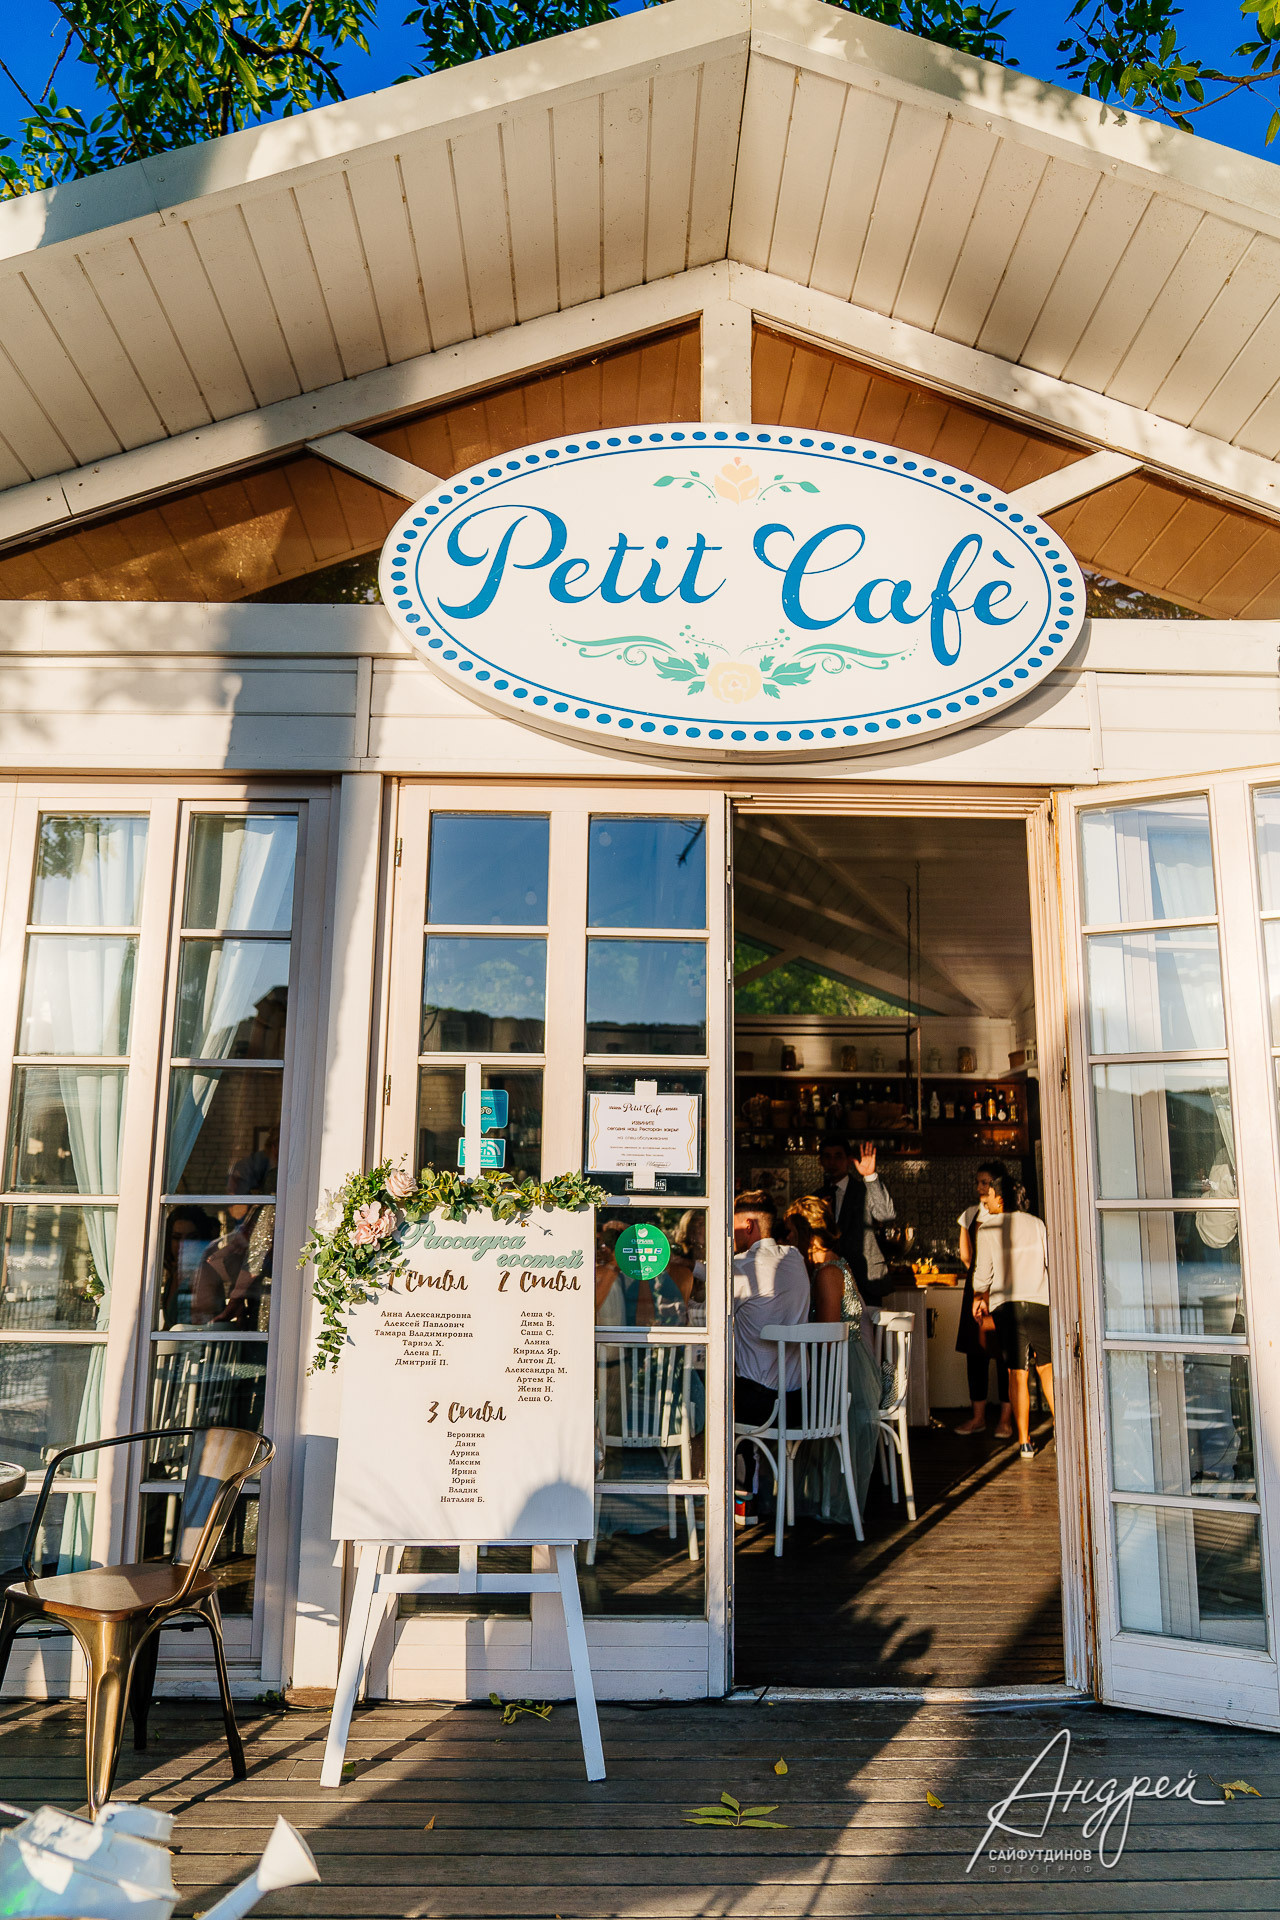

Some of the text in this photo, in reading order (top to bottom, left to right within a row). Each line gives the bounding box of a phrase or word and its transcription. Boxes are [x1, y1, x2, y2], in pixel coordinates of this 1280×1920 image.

[437, 504, 1029, 668] Petit Cafè
[400, 1220, 527, 1262] Рассадка
[496, 1250, 585, 1269] гостей
[497, 1270, 581, 1293] 2 Стол
[380, 1310, 472, 1321] Анна Александровна
[520, 1310, 543, 1318] Леша
[383, 1320, 465, 1329] Алексей Павлович
[520, 1320, 544, 1328] Дима
[374, 1329, 474, 1340] Тамара Владимировна
[545, 1329, 555, 1337] С.
[401, 1339, 433, 1348] Тариэл
[403, 1349, 430, 1357] Алена
[513, 1347, 561, 1357] Кирилл Яр.
[394, 1358, 437, 1368] Дмитрий
[516, 1357, 556, 1365] Антон Д.
[504, 1366, 556, 1376] Александра
[516, 1376, 544, 1385] Артем
[517, 1385, 554, 1393] Женя Н.
[426, 1400, 507, 1424] 3 Стол
[446, 1431, 486, 1440] Вероника
[454, 1440, 476, 1448] Даня
[450, 1449, 480, 1458] Аурика
[448, 1458, 481, 1466] Максим
[451, 1467, 477, 1476] Ирина
[451, 1477, 476, 1486] Юрий
[448, 1486, 478, 1494] Владик
[440, 1495, 485, 1503] Наталия Б.
